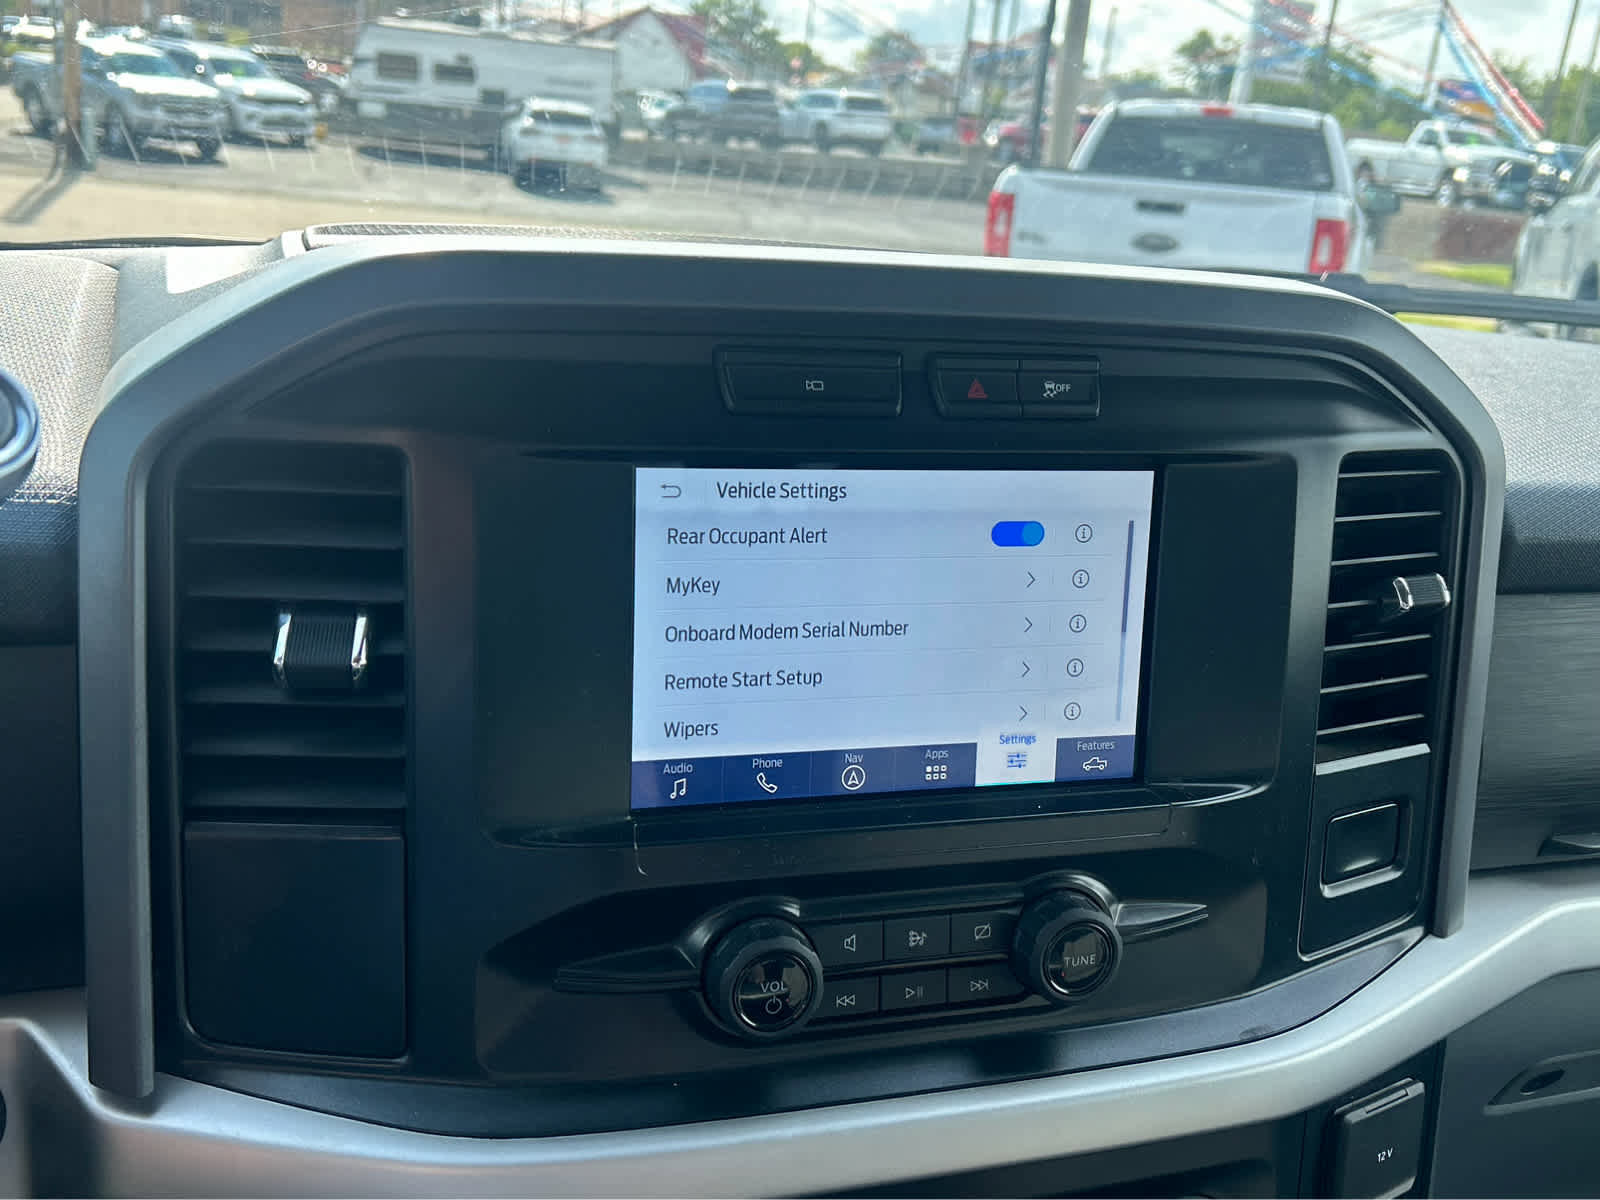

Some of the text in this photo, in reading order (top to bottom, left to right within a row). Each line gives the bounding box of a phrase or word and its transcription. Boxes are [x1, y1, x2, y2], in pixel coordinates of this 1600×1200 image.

[1055, 383, 1071, 392] OFF
[717, 481, 847, 502] Vehicle Settings
[667, 527, 828, 548] Rear Occupant Alert
[666, 576, 721, 596] MyKey
[665, 619, 909, 643] Onboard Modem Serial Number
[664, 670, 823, 691] Remote Start Setup
[664, 721, 719, 740] Wipers
[999, 734, 1036, 745] Settings
[1077, 740, 1115, 752] Features
[845, 753, 863, 763] Nav
[925, 749, 949, 760] Apps
[663, 763, 693, 775] Audio
[752, 758, 783, 769] Phone
[1063, 953, 1096, 968] TUNE
[760, 980, 788, 993] VOL
